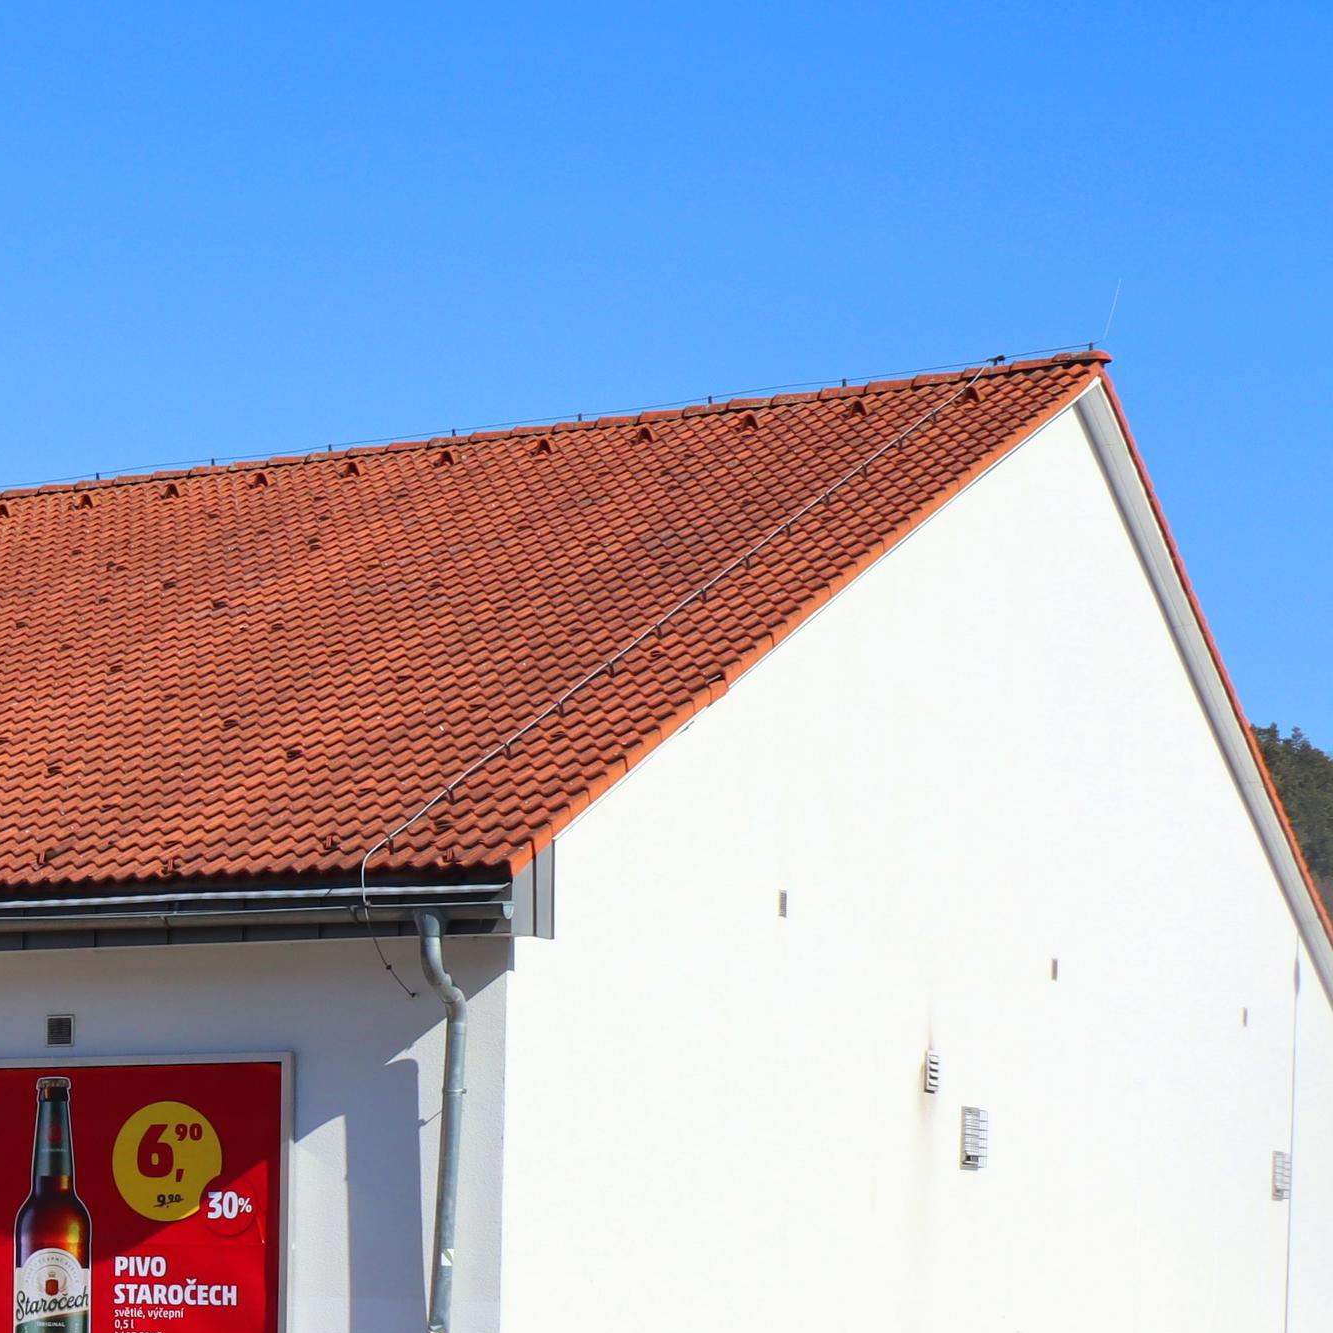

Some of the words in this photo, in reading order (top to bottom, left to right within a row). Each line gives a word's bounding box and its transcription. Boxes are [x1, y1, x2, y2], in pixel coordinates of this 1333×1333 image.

[115, 1257, 166, 1277] PIVO
[114, 1278, 237, 1306] STAROČECH
[16, 1285, 89, 1321] Staročech
[114, 1307, 145, 1319] světlé,
[147, 1307, 184, 1320] výčepní
[114, 1320, 129, 1330] 0,5
